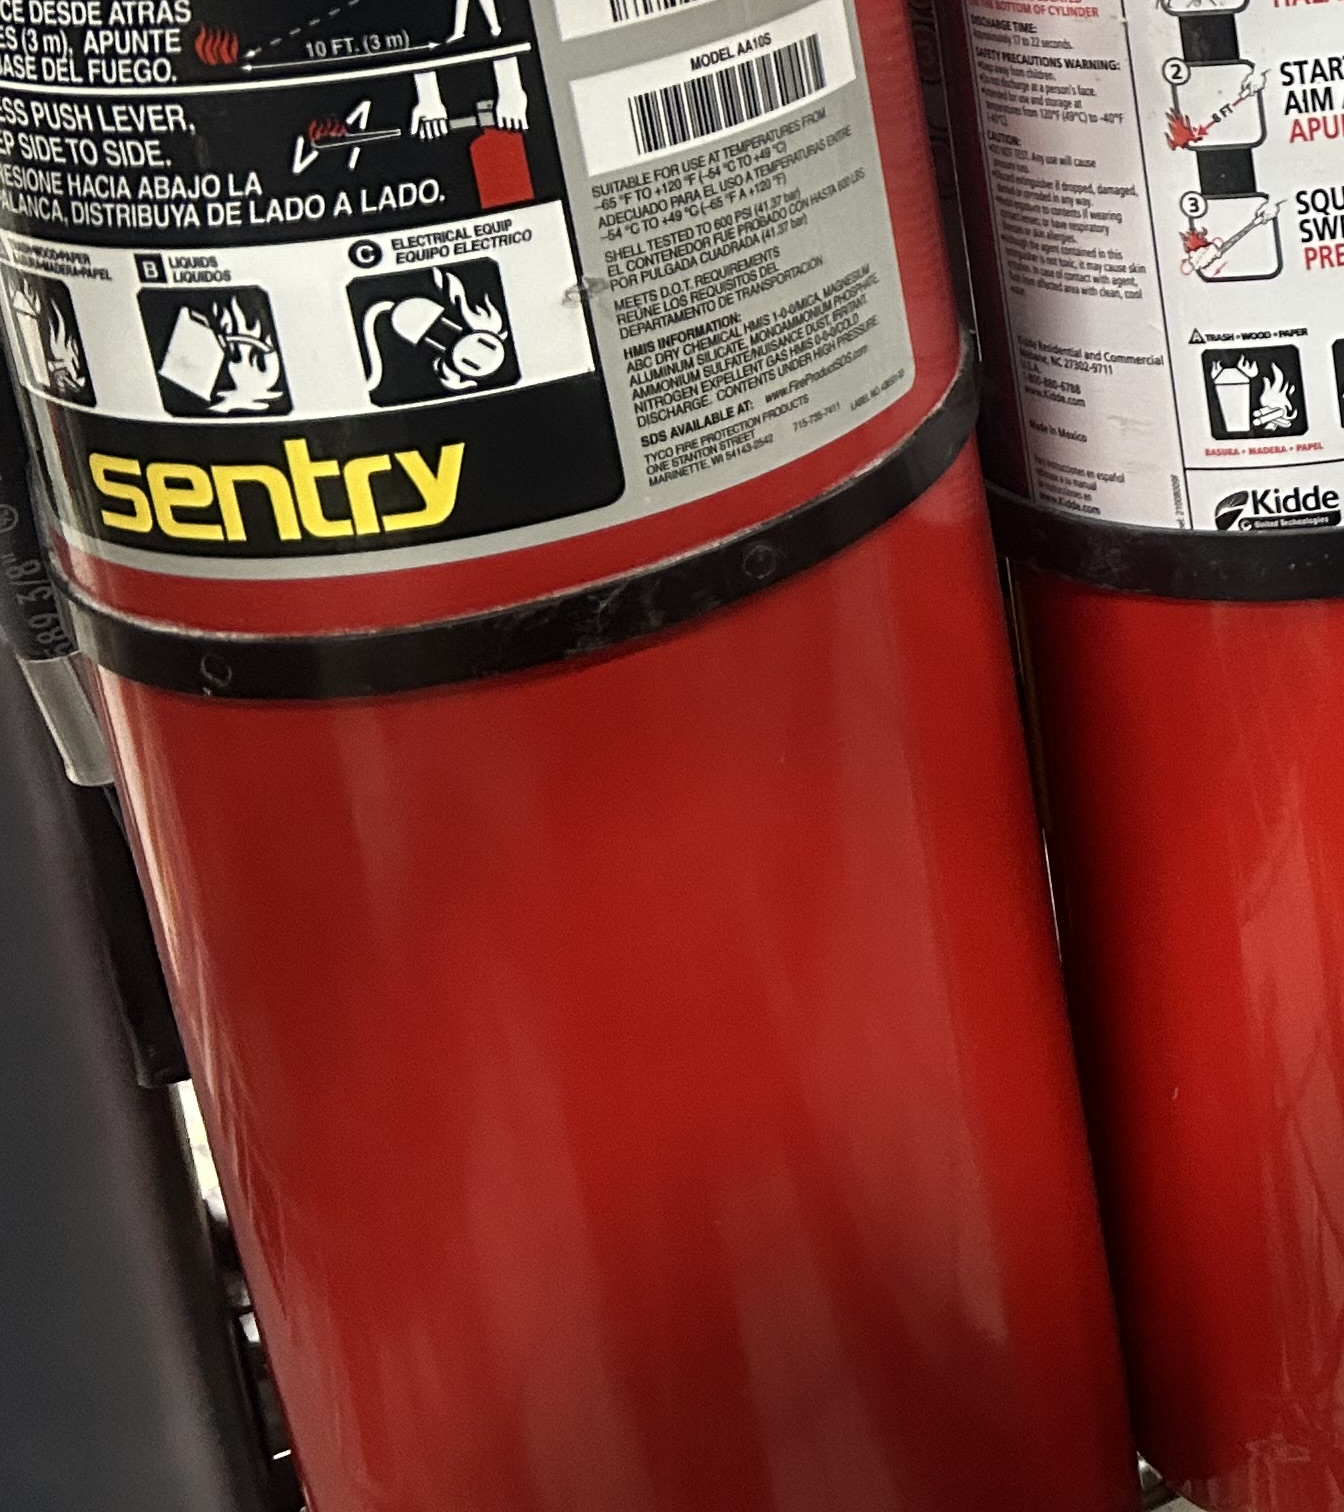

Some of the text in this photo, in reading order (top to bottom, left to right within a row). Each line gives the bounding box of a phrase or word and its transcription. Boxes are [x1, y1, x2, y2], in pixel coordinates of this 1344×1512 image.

[690, 46, 735, 71] MODEL
[1284, 86, 1335, 115] AIM
[33, 103, 195, 135] PUSH LEVER,
[71, 179, 445, 228] DISTRIBUYA DE LADO A LADO.
[391, 228, 471, 251] ELECTRICAL
[168, 255, 218, 269] LIQUIDS
[396, 245, 450, 265] EQUIPO
[1253, 486, 1339, 514] Kidde
